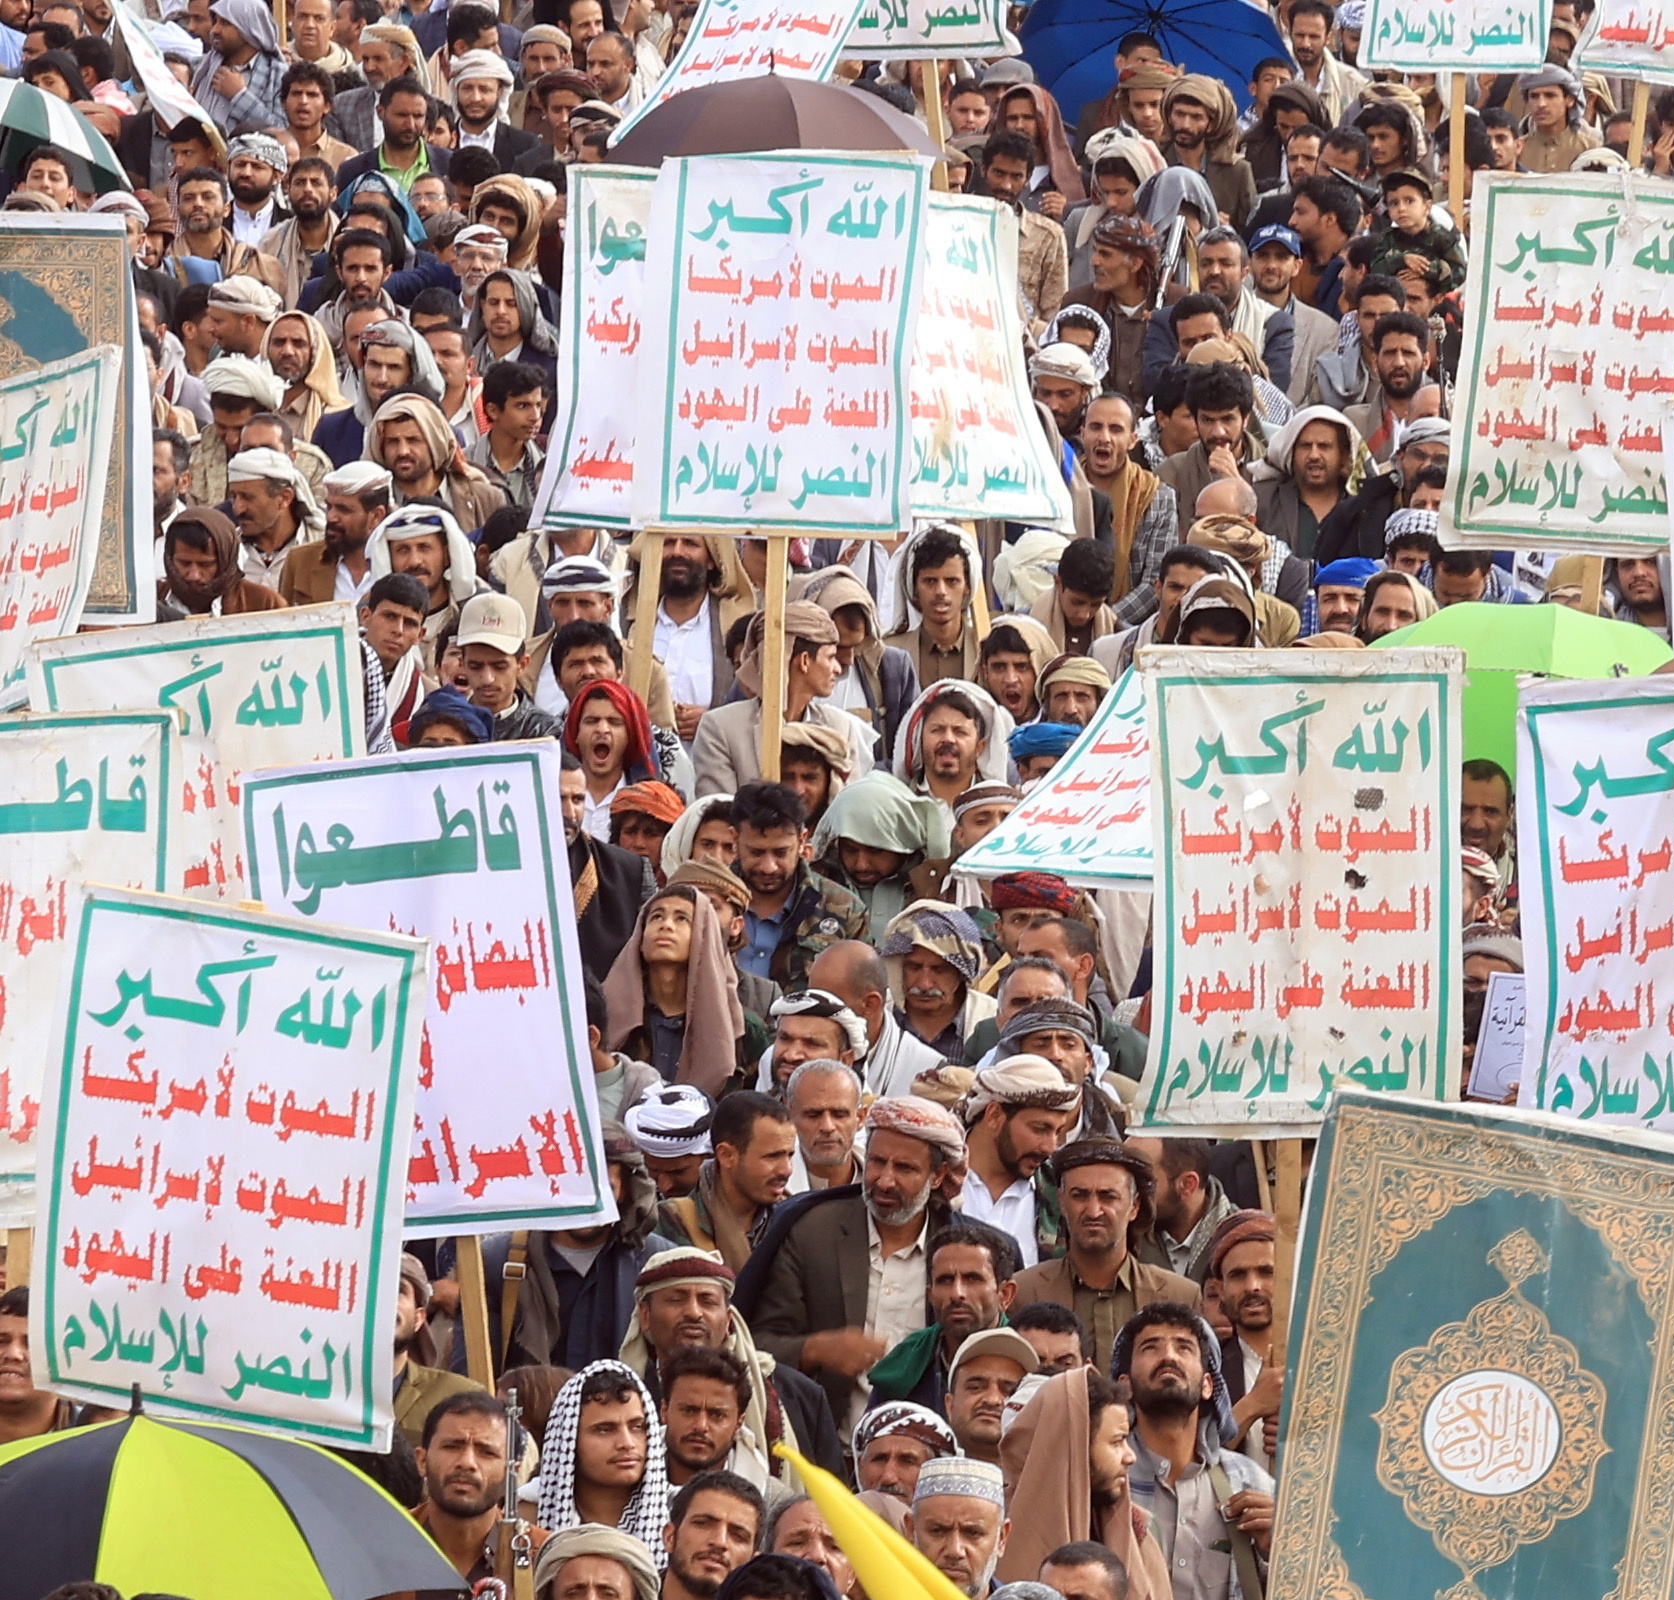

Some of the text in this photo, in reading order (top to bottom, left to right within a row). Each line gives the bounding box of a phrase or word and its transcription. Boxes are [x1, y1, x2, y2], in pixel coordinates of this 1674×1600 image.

[778, 16, 842, 35] الموت
[1368, 0, 1453, 60] للإسلام
[690, 169, 906, 250] الله أكبر
[688, 257, 896, 309] الموت لأمريكا
[1495, 287, 1603, 328] لأمريكا
[1485, 345, 1596, 395] لإسرائيل
[679, 387, 889, 432] اللعنة على اليهود
[29, 469, 84, 518] الموت
[675, 443, 886, 510] النصر للإسلام
[1180, 697, 1431, 798] الله أكبر
[274, 783, 521, 915] قاطعوا
[88, 940, 386, 1050] الله أكبر
[436, 920, 550, 1012] البضائع
[1179, 961, 1430, 1025] اللعنة على اليهود
[1491, 997, 1526, 1034] لقرآنية
[81, 1046, 376, 1142] الموت لأمريكا
[71, 1136, 367, 1229] الموت لإسرائيل
[63, 1228, 358, 1314] اللعنة على اليهود
[64, 1302, 351, 1400] النصر للإسلام
